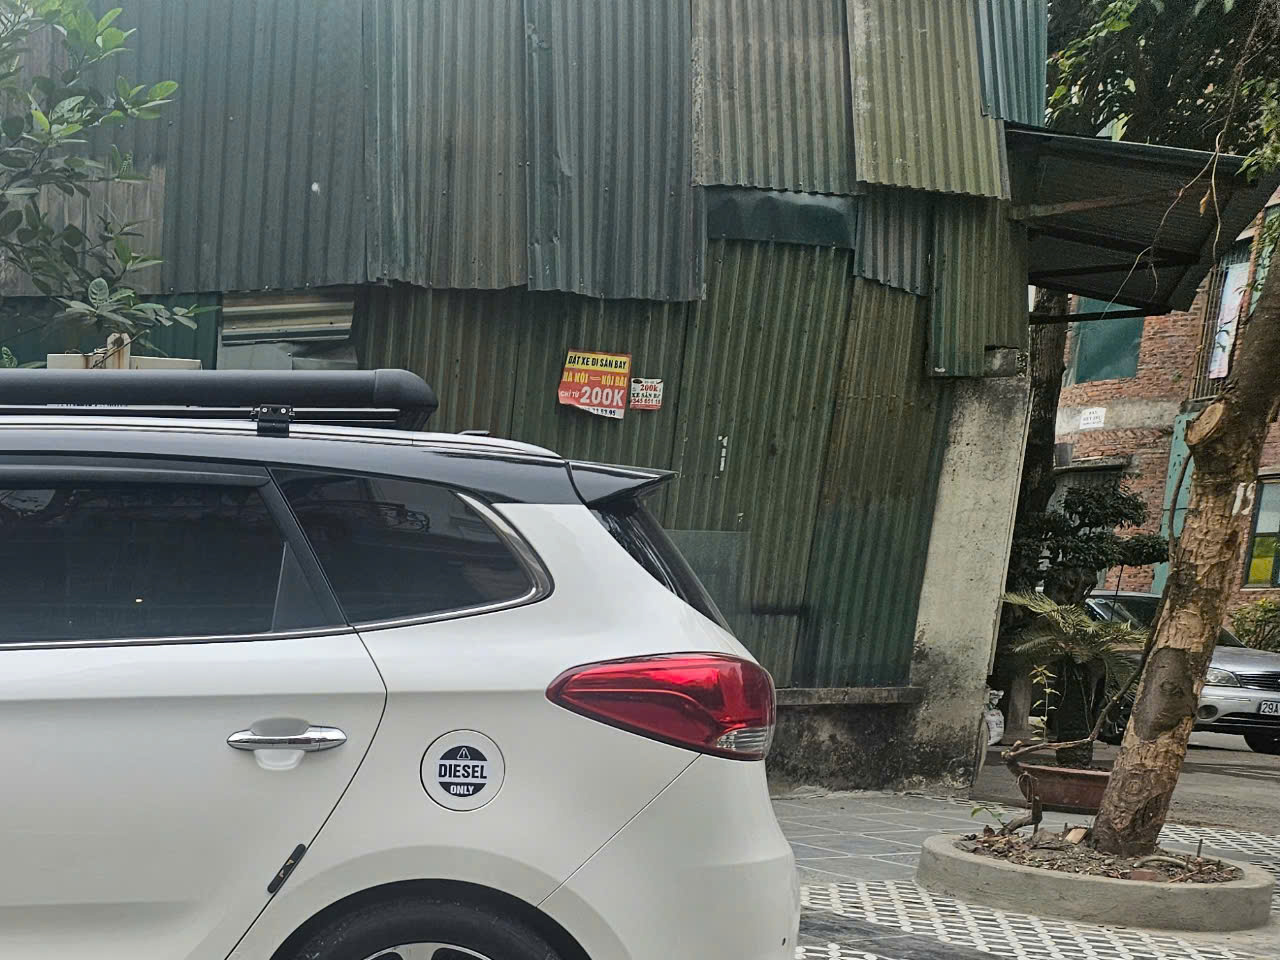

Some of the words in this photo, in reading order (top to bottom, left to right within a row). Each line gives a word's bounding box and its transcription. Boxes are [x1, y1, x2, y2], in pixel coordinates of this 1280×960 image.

[581, 356, 591, 366] XE
[614, 360, 627, 369] BAY
[580, 385, 625, 407] 200K
[438, 763, 487, 779] DIESEL
[450, 785, 474, 795] ONLY
